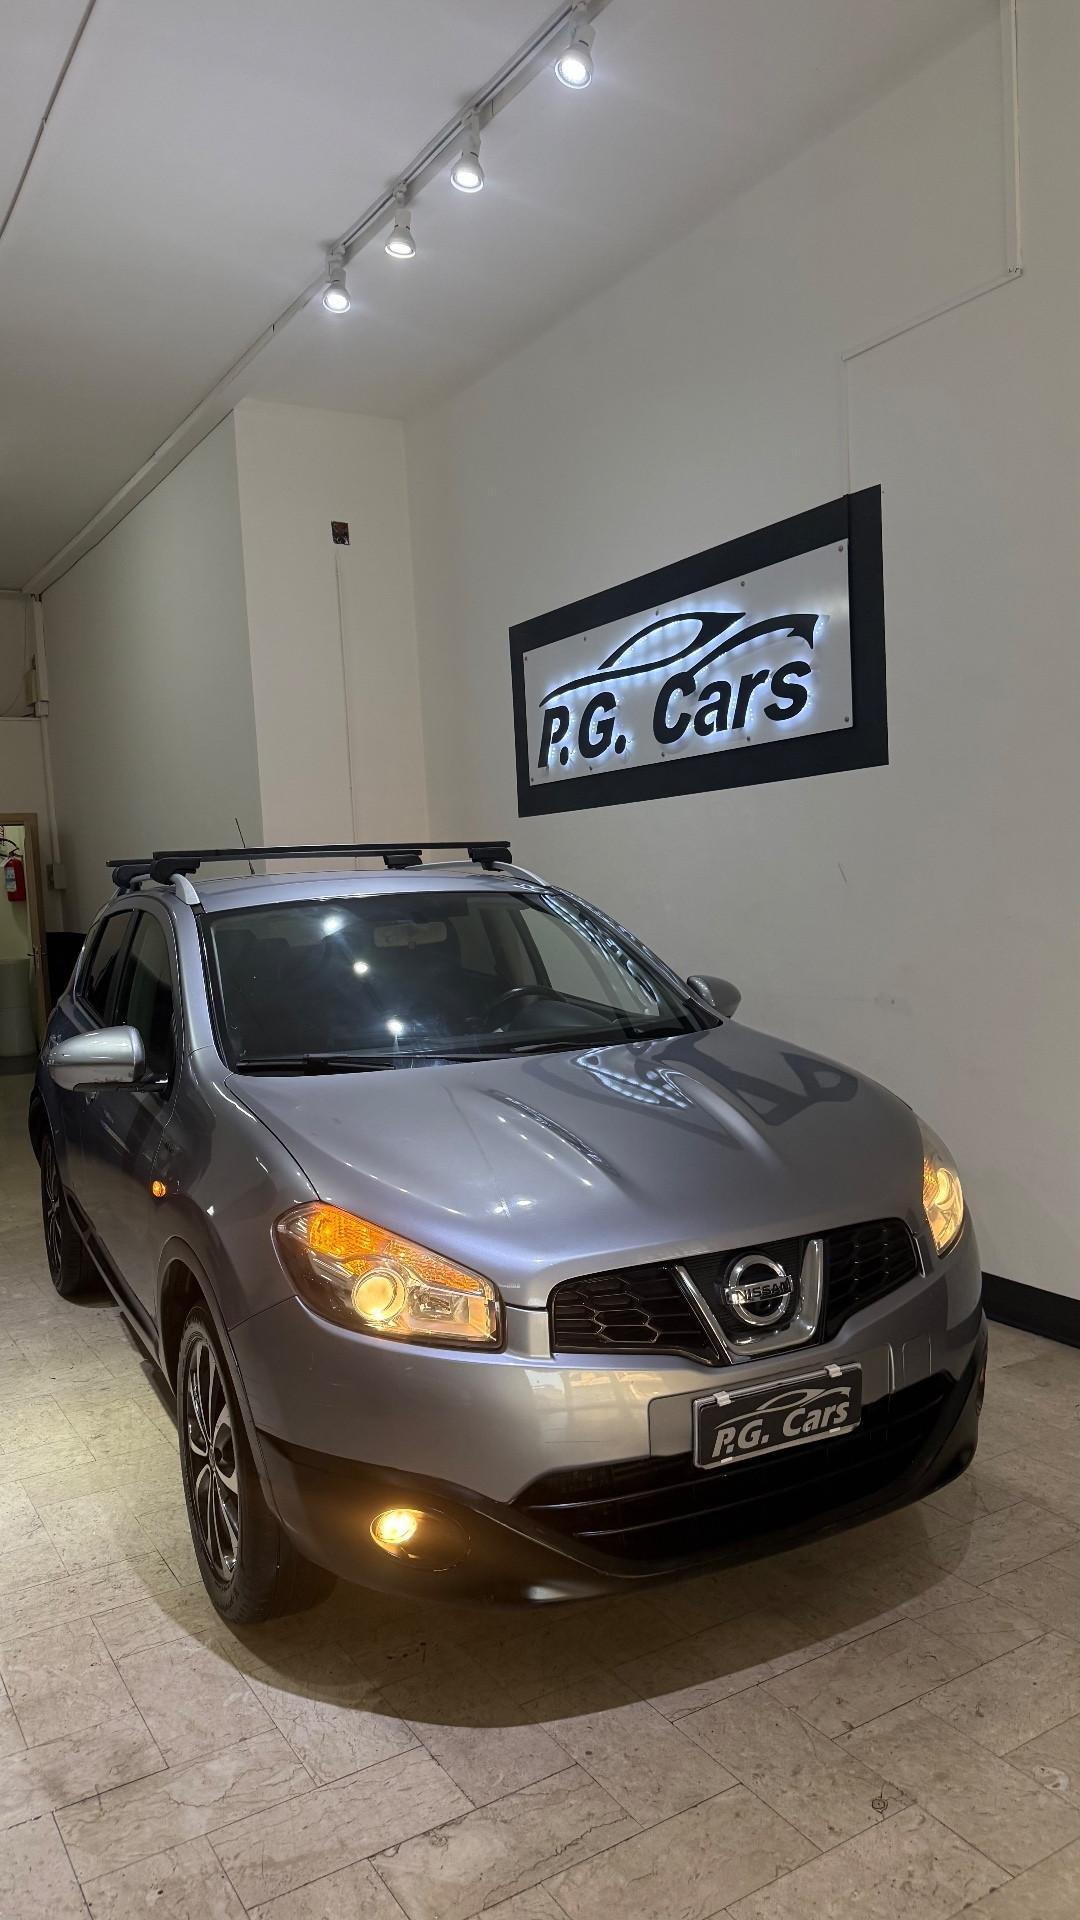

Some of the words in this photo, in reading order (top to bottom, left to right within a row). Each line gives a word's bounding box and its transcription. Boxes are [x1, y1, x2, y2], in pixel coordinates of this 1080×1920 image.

[538, 692, 627, 767] P.G.
[653, 661, 811, 744] Cars
[735, 1279, 790, 1302] NISSAN
[711, 1418, 770, 1458] P.G.
[782, 1401, 850, 1437] Cars
